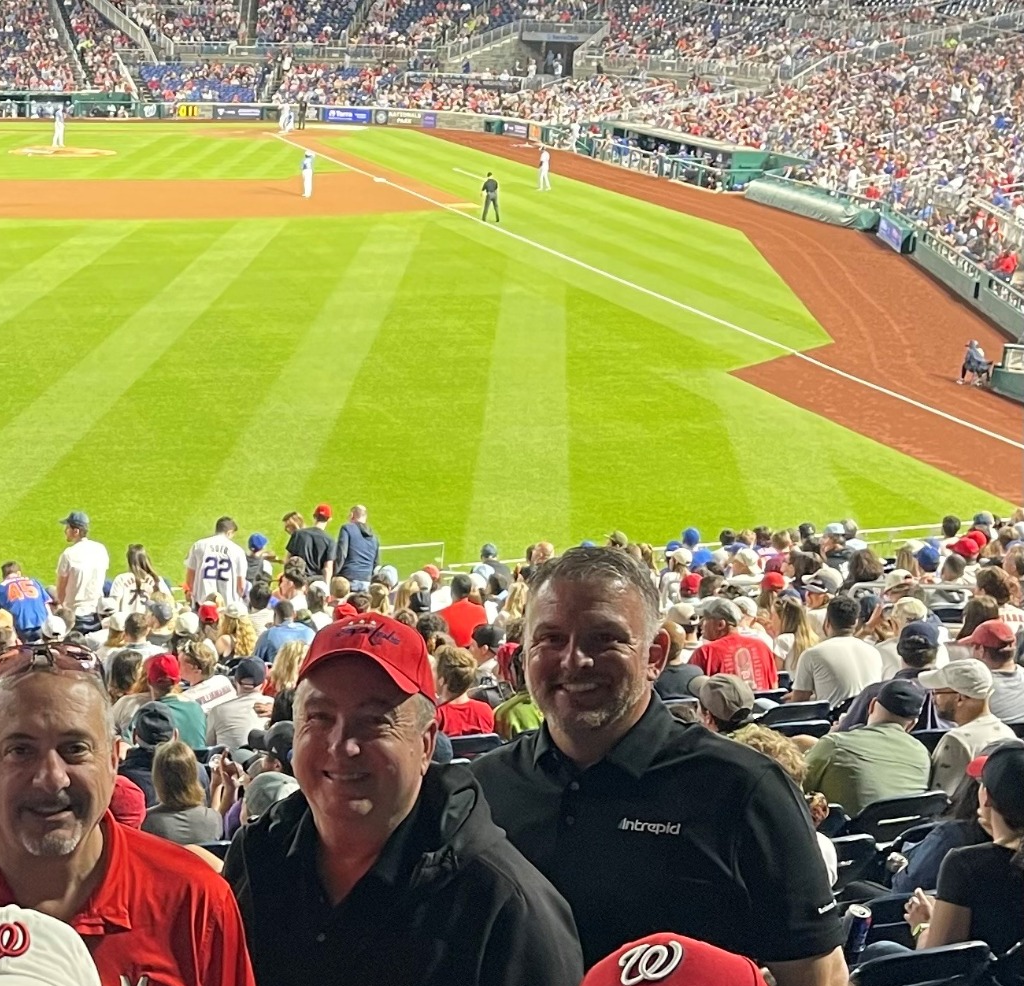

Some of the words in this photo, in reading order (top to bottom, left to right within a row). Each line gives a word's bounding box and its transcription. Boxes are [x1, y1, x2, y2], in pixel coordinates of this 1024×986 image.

[388, 110, 421, 119] NATIONALS
[203, 556, 232, 581] 22
[8, 580, 39, 602] 45
[618, 817, 682, 835] Intrepid
[618, 940, 683, 986] W
